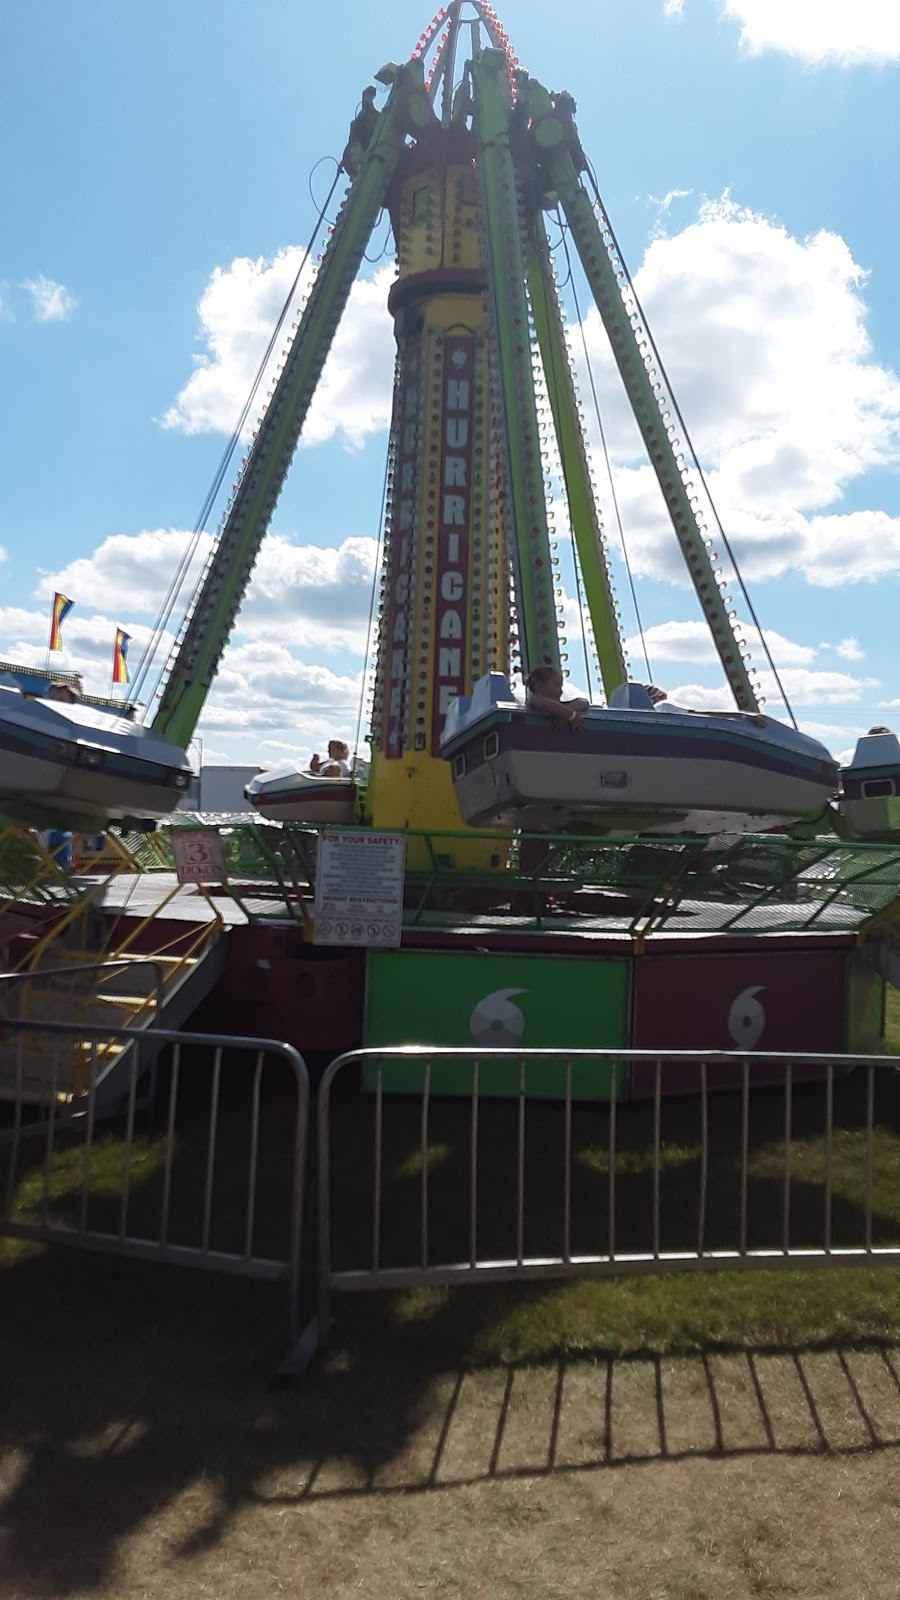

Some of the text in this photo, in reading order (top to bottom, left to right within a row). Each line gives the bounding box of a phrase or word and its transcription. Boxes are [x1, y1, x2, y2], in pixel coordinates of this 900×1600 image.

[438, 379, 470, 717] HURRICANE
[323, 834, 341, 844] FOR
[342, 835, 365, 845] YOUR
[189, 843, 209, 861] 3
